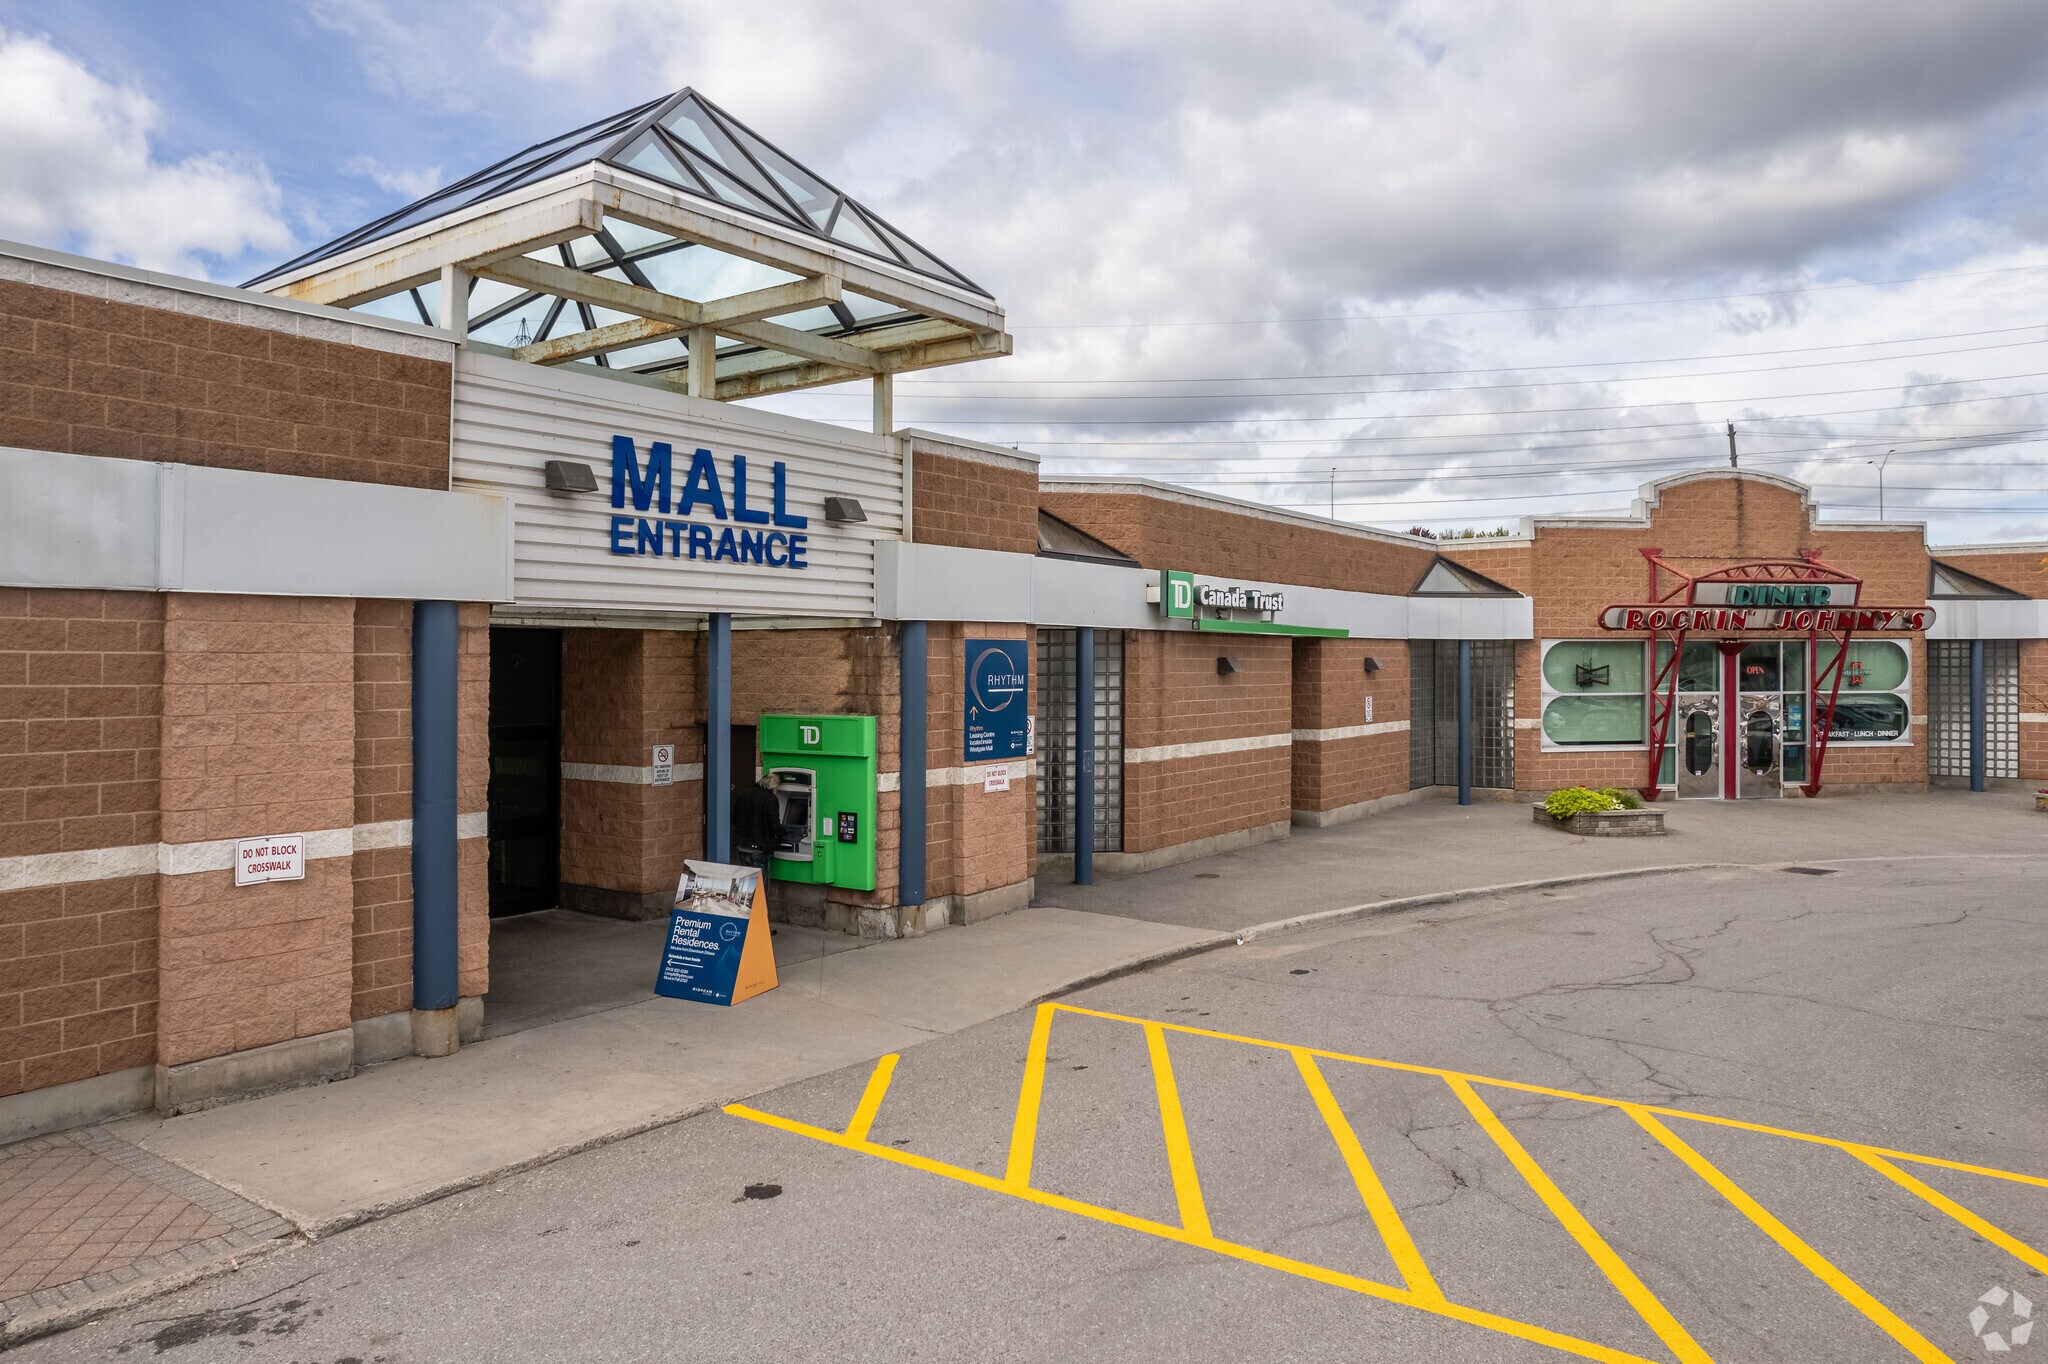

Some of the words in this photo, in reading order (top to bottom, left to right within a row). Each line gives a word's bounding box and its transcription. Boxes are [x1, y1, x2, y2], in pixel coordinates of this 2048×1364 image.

[611, 434, 808, 529] MALL
[611, 516, 808, 568] ENTRANCE
[1170, 580, 1192, 609] TD
[1200, 585, 1247, 608] Canada
[1252, 590, 1284, 611] Trust
[1732, 585, 1832, 606] DINER
[1625, 609, 1756, 631] ROCKIN'
[1774, 609, 1925, 631] JOHNNY'S
[1746, 666, 1765, 674] OPEN
[988, 674, 1024, 686] RHYTHM
[800, 726, 820, 744] TD
[243, 849, 253, 859] DO
[256, 847, 268, 857] NOT
[272, 845, 297, 856] BLOCK
[248, 861, 291, 874] CROSSWALK
[676, 916, 711, 930] Premium
[673, 926, 700, 938] Rental
[671, 935, 720, 951] Residences.
